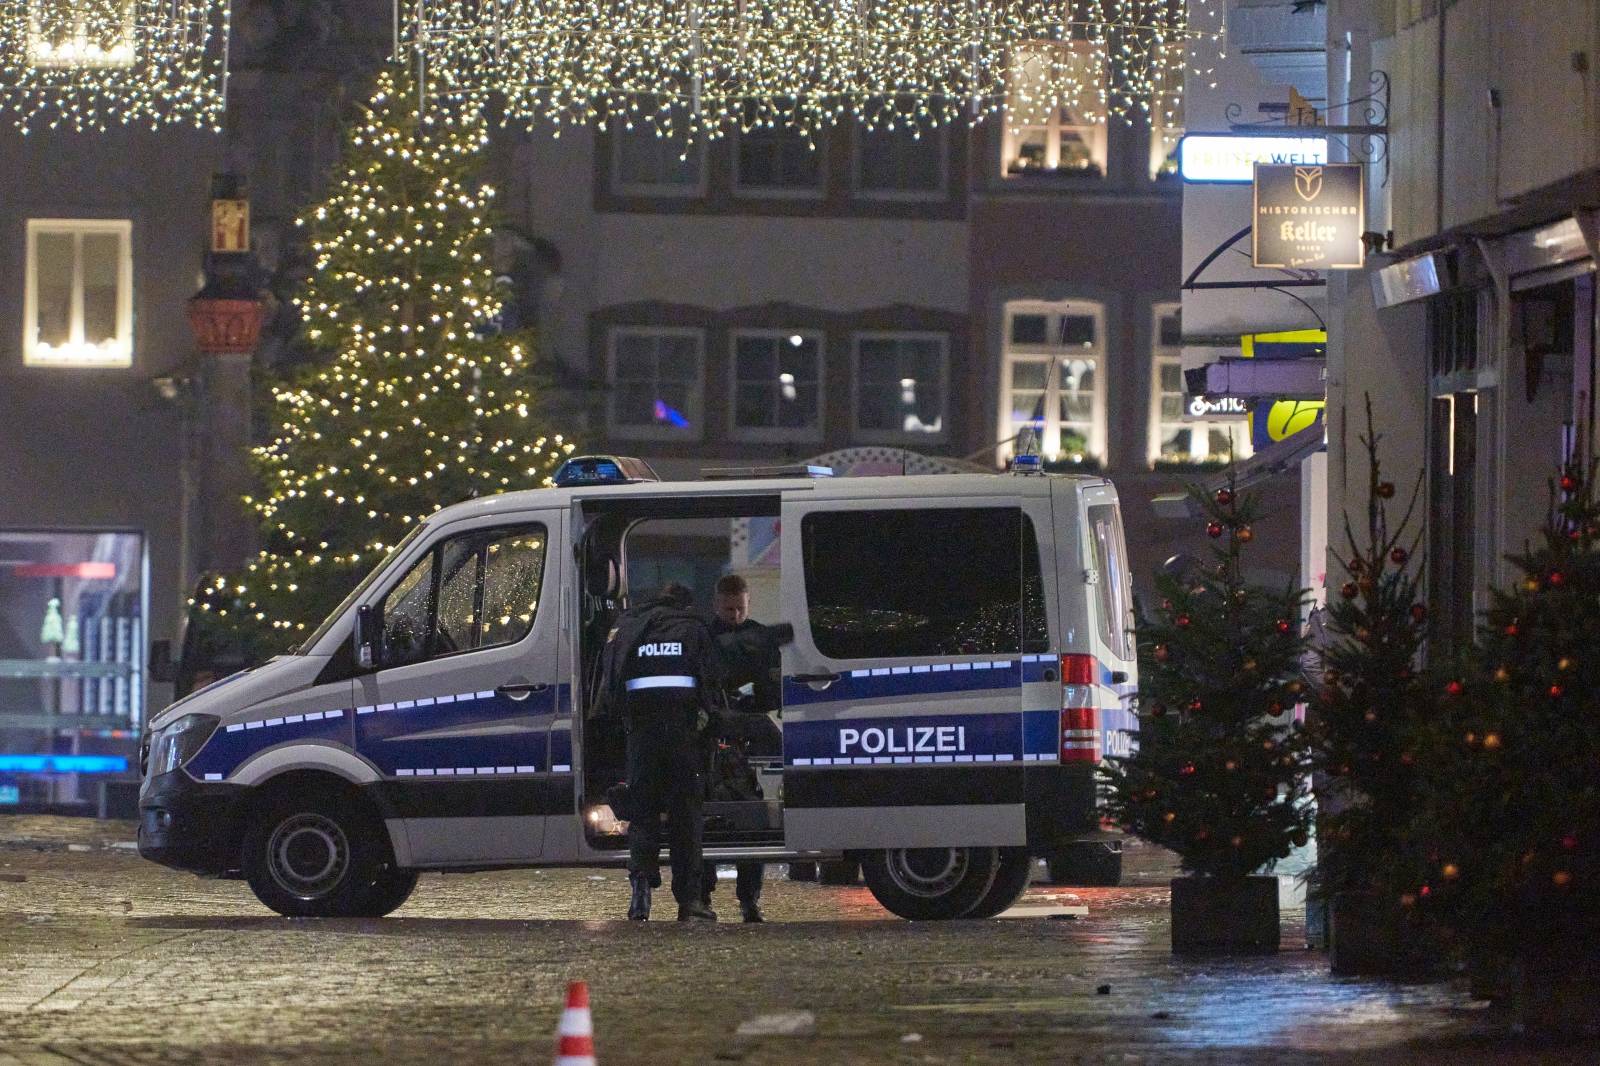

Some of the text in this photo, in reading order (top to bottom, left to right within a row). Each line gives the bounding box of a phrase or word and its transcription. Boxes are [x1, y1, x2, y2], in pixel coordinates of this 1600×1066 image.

[1260, 206, 1357, 216] HISTORISCHER
[1280, 220, 1337, 242] Keller
[638, 642, 683, 657] POLIZEI
[839, 726, 965, 754] POLIZEI
